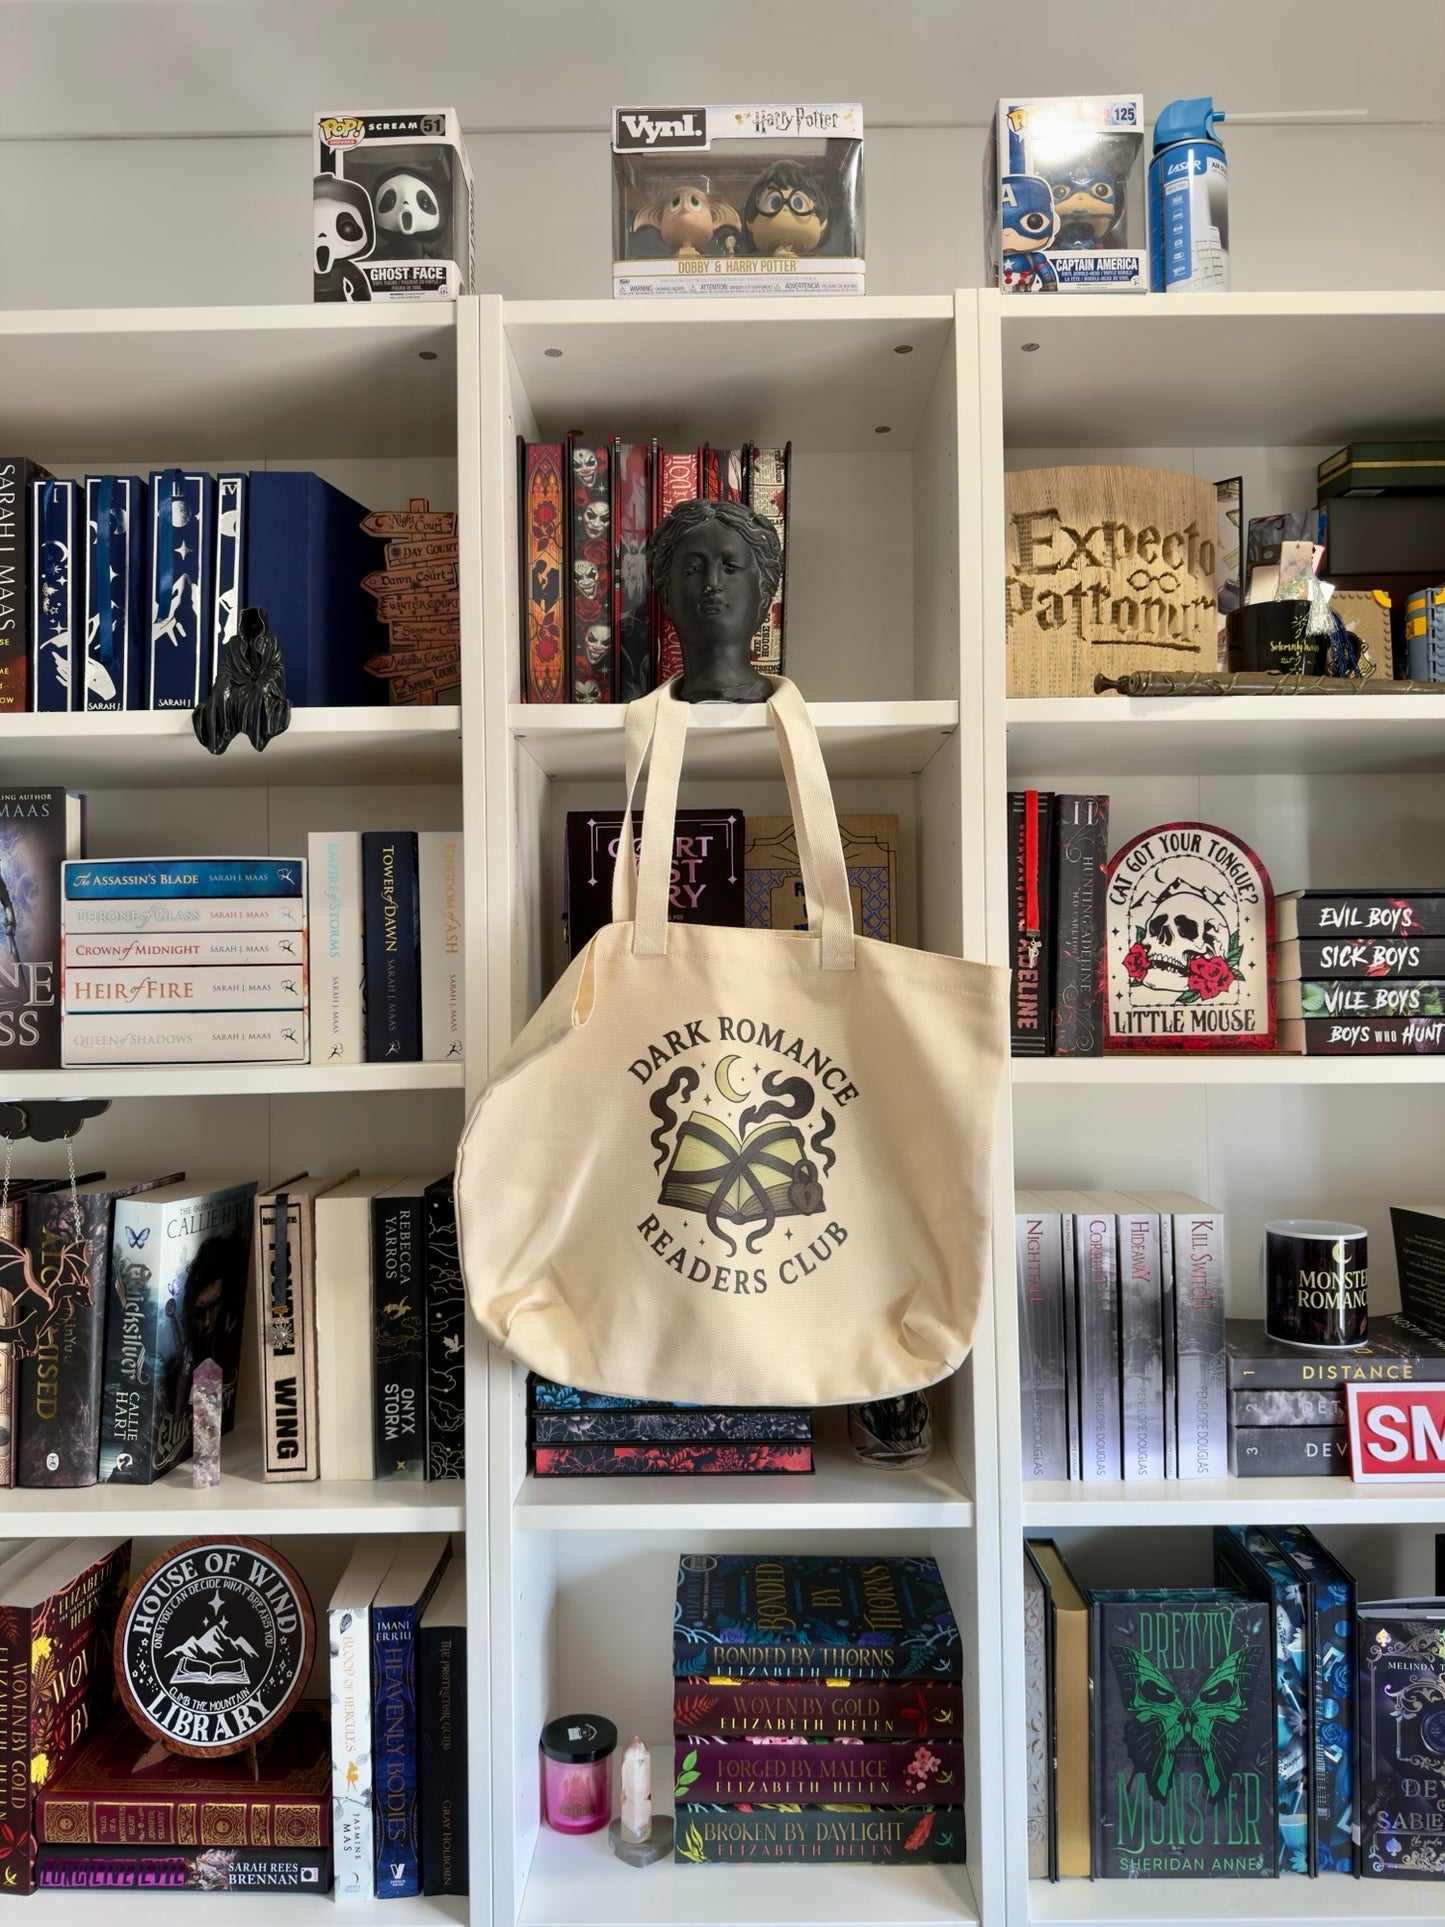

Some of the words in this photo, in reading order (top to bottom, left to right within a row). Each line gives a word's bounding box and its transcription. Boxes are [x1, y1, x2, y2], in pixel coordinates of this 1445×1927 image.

[318, 118, 364, 138] POP!
[368, 122, 418, 130] SCREAM
[424, 118, 441, 132] 51
[755, 110, 794, 134] Harry
[795, 108, 838, 135] Potter
[1114, 108, 1135, 120] 125
[371, 268, 409, 280] GHOST
[413, 267, 443, 280] FACE
[678, 260, 709, 274] DOBBY
[714, 261, 721, 272] &
[726, 260, 758, 273] HARRY
[761, 260, 796, 272] POTTER
[1056, 258, 1094, 272] CAPTAIN
[1097, 258, 1137, 270] AMERICA
[415, 517, 442, 532] Court
[381, 574, 411, 586] Dawn
[415, 569, 445, 582] Court
[403, 625, 437, 636] Summer
[92, 874, 156, 885] ASSASSIN'S
[160, 874, 199, 884] BLADE
[383, 845, 394, 892] TOWER
[444, 844, 456, 910] KINGDOM
[1109, 873, 1133, 906] CAT
[1126, 842, 1156, 873] GOT
[1158, 832, 1202, 854] YOUR
[1207, 838, 1258, 904] TONGUE?
[1082, 856, 1094, 924] HUNTING
[76, 910, 138, 922] THRONE
[154, 908, 199, 921] GLASS
[329, 902, 340, 958] STORMS
[384, 905, 397, 951] DAWN
[1319, 902, 1363, 928] EVIL
[1363, 907, 1413, 933] BOYS
[76, 945, 120, 956] CROWN
[135, 945, 200, 955] MIDNIGHT
[445, 925, 458, 954] ASH
[1080, 930, 1092, 993] ADELINE
[1320, 945, 1370, 968] SICK
[1372, 946, 1420, 973] BOYS
[75, 982, 129, 999] HEIR
[147, 981, 194, 998] FIRE
[1325, 984, 1370, 1013] VILE
[1370, 988, 1420, 1013] BOYS
[1113, 1009, 1185, 1034] LITTLE
[1190, 1008, 1256, 1033] MOUSE
[1326, 1026, 1370, 1047] BOYS
[1375, 1031, 1397, 1043] WHO
[1402, 1023, 1445, 1045] HUNT
[73, 1034, 119, 1046] QUEEN
[131, 1033, 193, 1045] SHADOWS
[628, 1020, 711, 1085] DARK
[717, 1016, 860, 1107] ROMANCE
[385, 1216, 397, 1279] YARROS
[400, 1210, 411, 1284] REBECCA
[1191, 1220, 1213, 1249] KILL
[637, 1213, 768, 1295] READERS
[779, 1221, 848, 1284] CLUB
[1089, 1219, 1108, 1287] CORRUPT
[1131, 1220, 1150, 1284] HIDEAWAY
[1190, 1253, 1213, 1310] SWITCH
[1302, 1366, 1413, 1380] DISTANCE
[114, 1391, 128, 1440] HART
[127, 1392, 140, 1440] CALLIE
[385, 1384, 400, 1440] STORM
[400, 1388, 415, 1433] ONYX
[1033, 1377, 1043, 1424] PENELOPE
[1095, 1386, 1105, 1438] PENELOPE
[1137, 1386, 1146, 1438] PENELOPE
[1197, 1385, 1208, 1432] PENELOPE
[274, 1377, 298, 1459] WING
[1033, 1426, 1043, 1475] DOUGLAS
[1095, 1440, 1105, 1476] DOUGLAS
[1137, 1440, 1147, 1475] DOUGLAS
[1197, 1433, 1208, 1474] DOUGLAS
[132, 1559, 198, 1634] HOUSE
[205, 1553, 240, 1574] OF
[248, 1560, 298, 1633] WIND
[70, 1597, 99, 1630] HELEN
[154, 1624, 165, 1649] ONLY
[160, 1607, 174, 1624] YOU
[170, 1590, 189, 1609] CAN
[188, 1579, 220, 1596] DECIDE
[223, 1580, 249, 1596] WHAT
[264, 1630, 273, 1648] YOU
[377, 1622, 410, 1631] IMANI
[376, 1631, 412, 1641] ERRIU
[342, 1636, 355, 1681] BLOOD
[714, 1647, 786, 1665] BONDED
[791, 1648, 816, 1664] BY
[820, 1647, 894, 1666] THORNS
[1388, 1662, 1434, 1671] MELINDA
[717, 1667, 820, 1677] ELIZABETH
[834, 1668, 890, 1678] HELEN
[12, 1662, 27, 1727] WOVEN
[192, 1699, 208, 1711] THE
[210, 1687, 250, 1711] MOUNTAIN
[385, 1647, 404, 1754] HEAVENLY
[734, 1697, 798, 1716] WOVEN
[804, 1698, 826, 1716] BY
[832, 1698, 880, 1716] GOLD
[147, 1690, 270, 1742] LIBRARY
[344, 1695, 356, 1752] HERCULES
[721, 1717, 823, 1731] ELIZABETH
[838, 1719, 894, 1732] HELEN
[12, 1732, 26, 1754] BY
[11, 1760, 26, 1808] GOLD
[718, 1760, 786, 1778] FORGED
[792, 1760, 816, 1778] BY
[820, 1760, 886, 1778] MALICE
[386, 1758, 406, 1840] BODIES
[716, 1782, 819, 1793] ELIZABETH
[834, 1782, 890, 1793] HELEN
[1114, 1772, 1262, 1854] MONSTER
[343, 1824, 351, 1852] MAS
[353, 1813, 361, 1860] JASMINE
[704, 1823, 776, 1841] BROKEN
[784, 1823, 808, 1841] BY
[817, 1822, 904, 1841] DAYLIGHT
[443, 1826, 452, 1886] HOLBORN
[718, 1844, 820, 1855] ELIZABETH
[836, 1844, 892, 1856] HELEN
[1120, 1857, 1204, 1871] SHERIDAN
[1212, 1858, 1256, 1870] ANNE
[228, 1862, 266, 1872] SARAH
[270, 1863, 298, 1872] REES
[228, 1874, 298, 1885] BRENNAN
